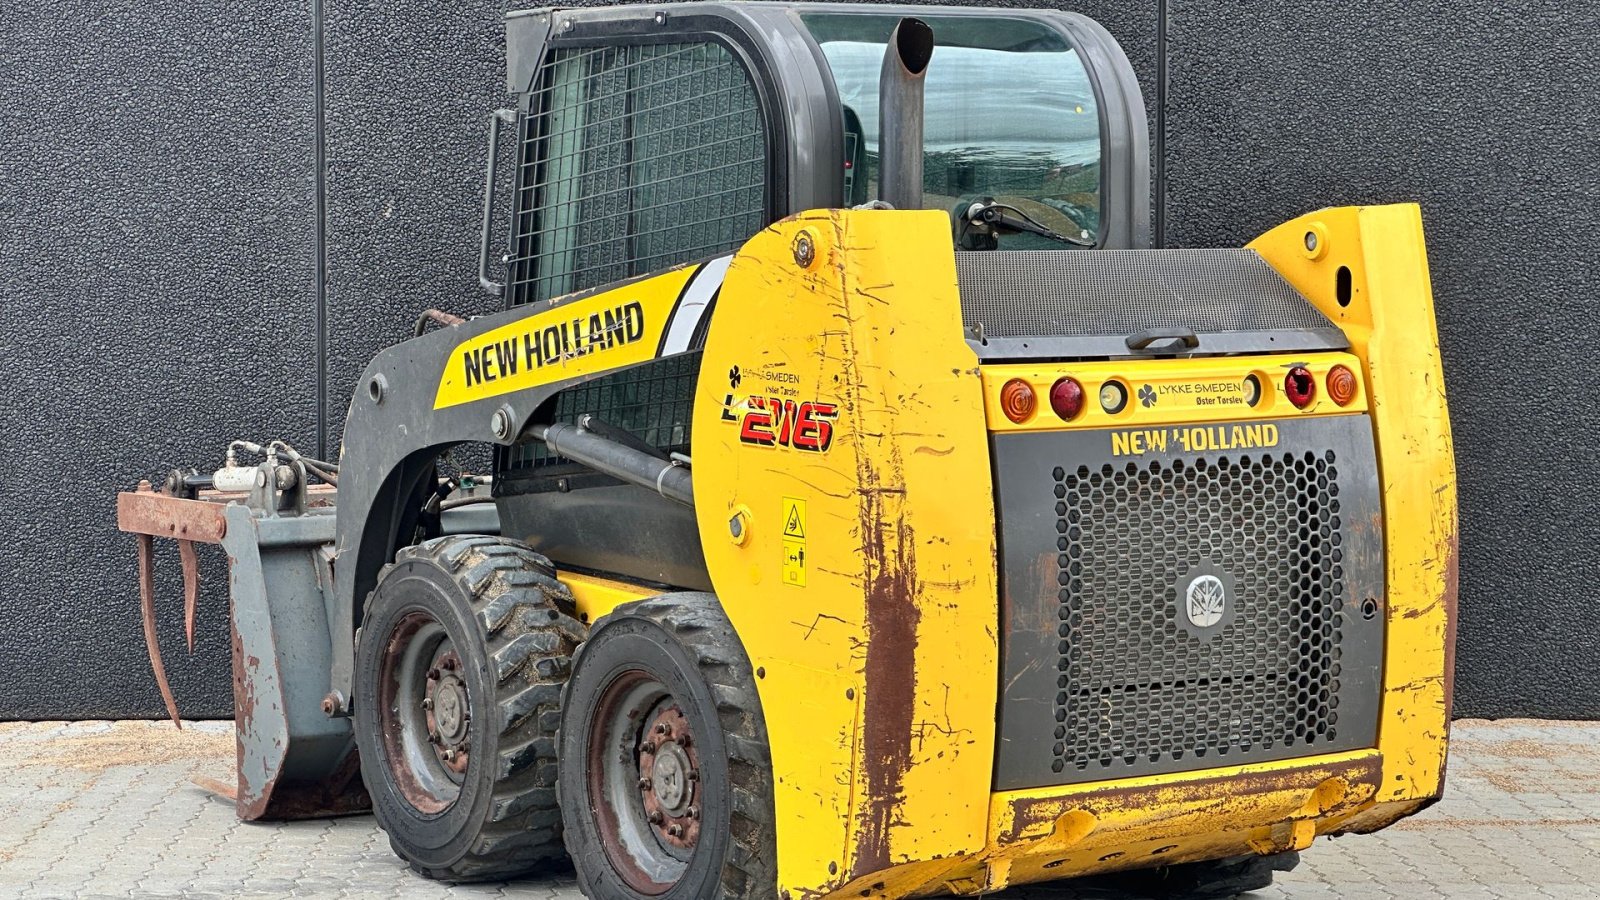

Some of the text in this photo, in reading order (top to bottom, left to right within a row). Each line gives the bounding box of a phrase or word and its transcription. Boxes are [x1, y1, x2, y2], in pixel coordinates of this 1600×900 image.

[463, 301, 644, 387] NEW HOLLAND
[765, 371, 800, 384] SMEDEN
[1159, 382, 1241, 394] LYKKE SMEDEN
[1196, 395, 1243, 405] Øster Tørslev
[1111, 423, 1279, 456] NEW HOLLAND
